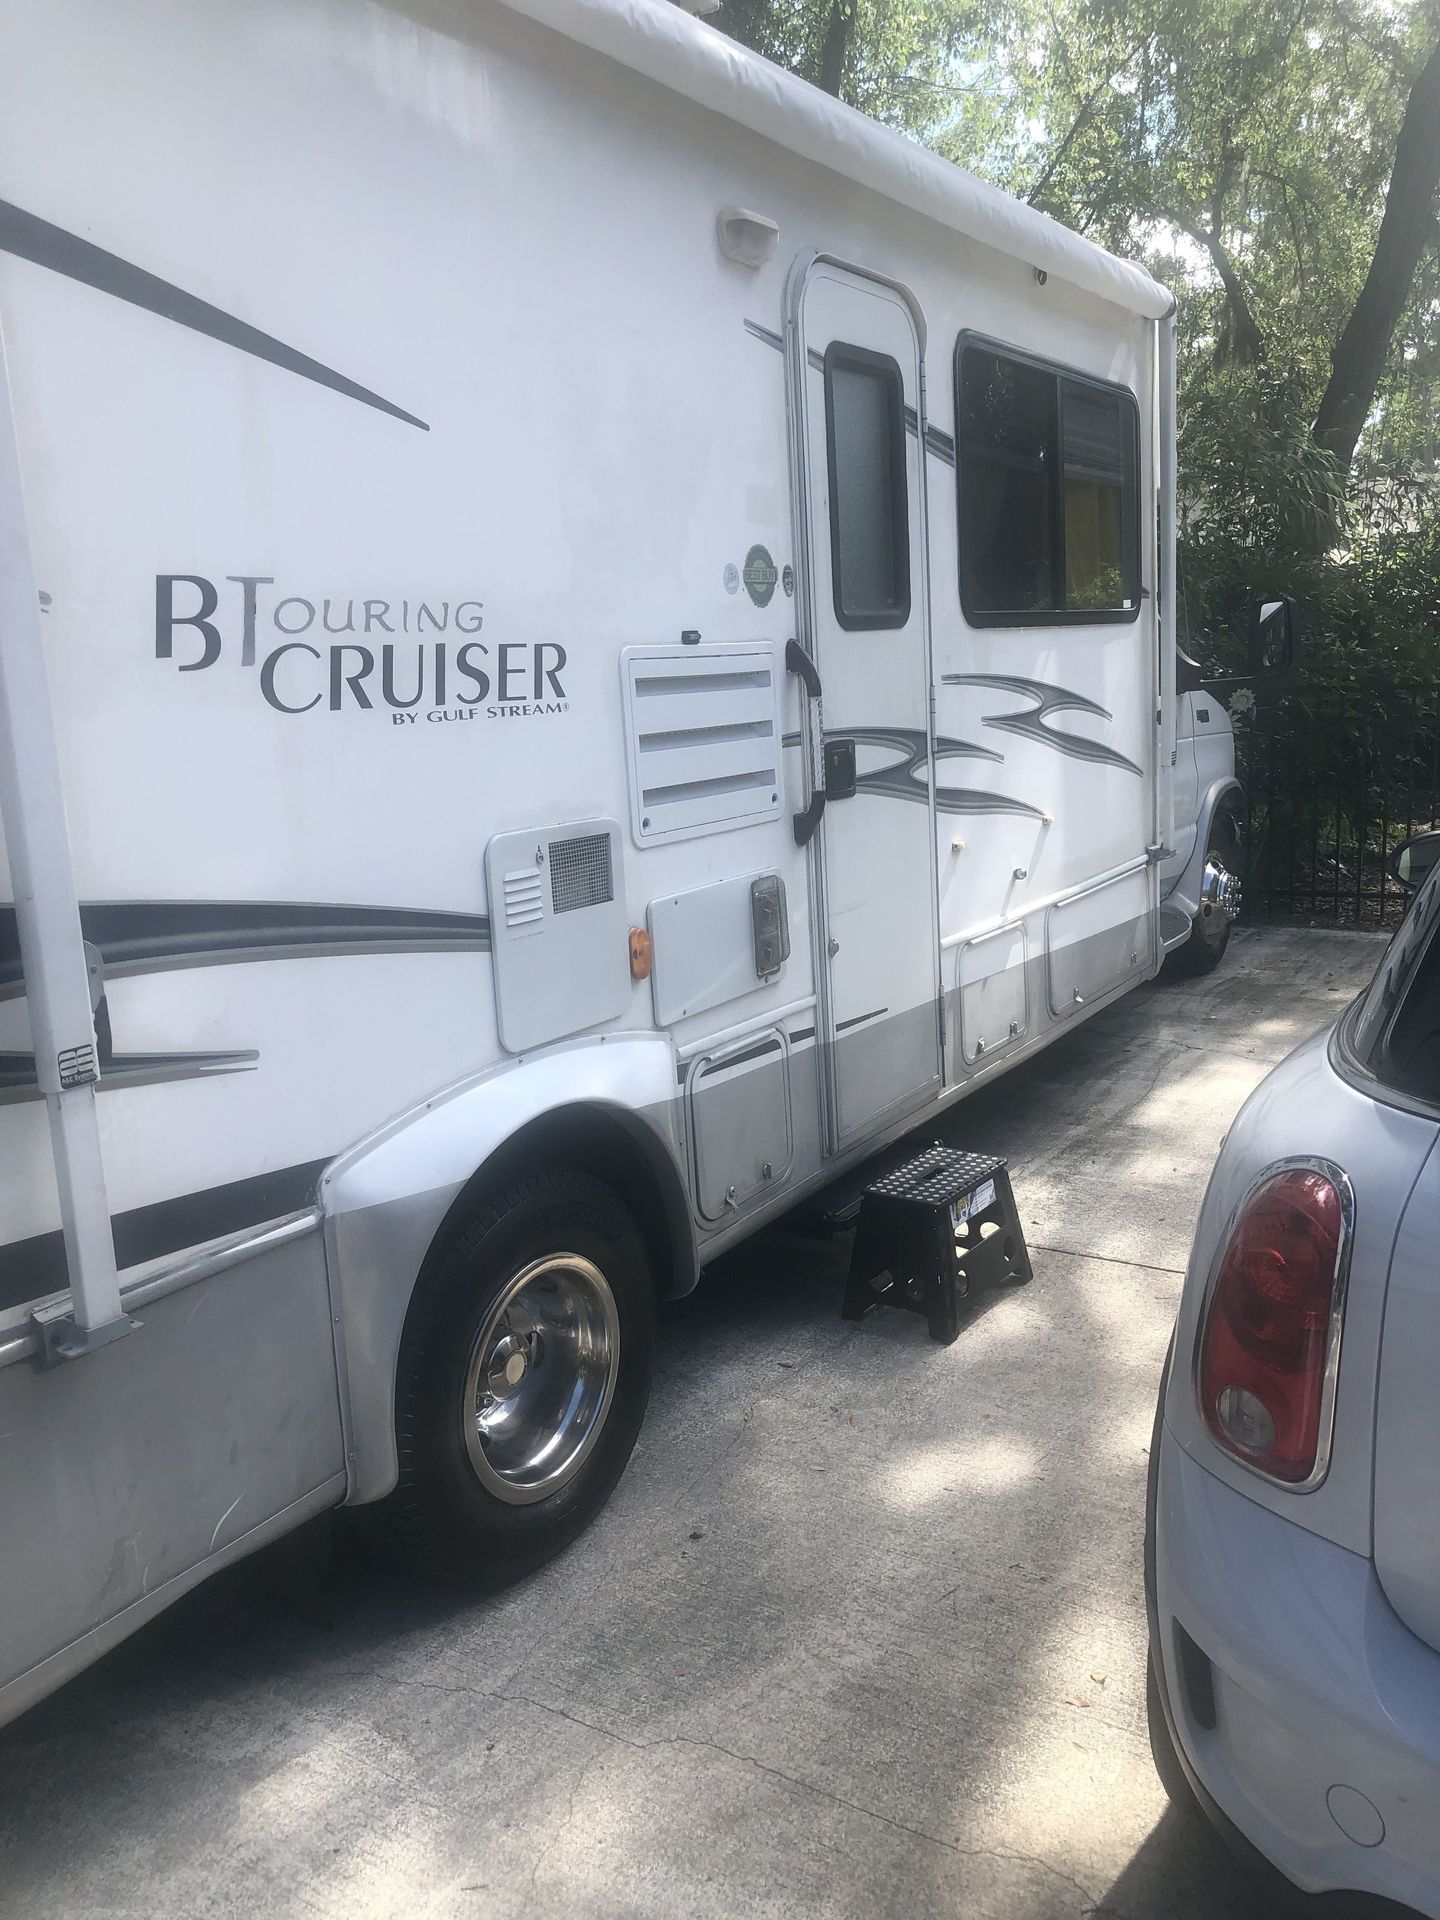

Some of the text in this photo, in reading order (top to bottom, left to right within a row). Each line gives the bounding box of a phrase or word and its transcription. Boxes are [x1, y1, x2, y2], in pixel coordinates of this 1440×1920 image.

[745, 569, 775, 580] BEST BUY
[260, 642, 567, 714] CRUISER
[392, 712, 418, 725] BY
[426, 708, 478, 723] GULF
